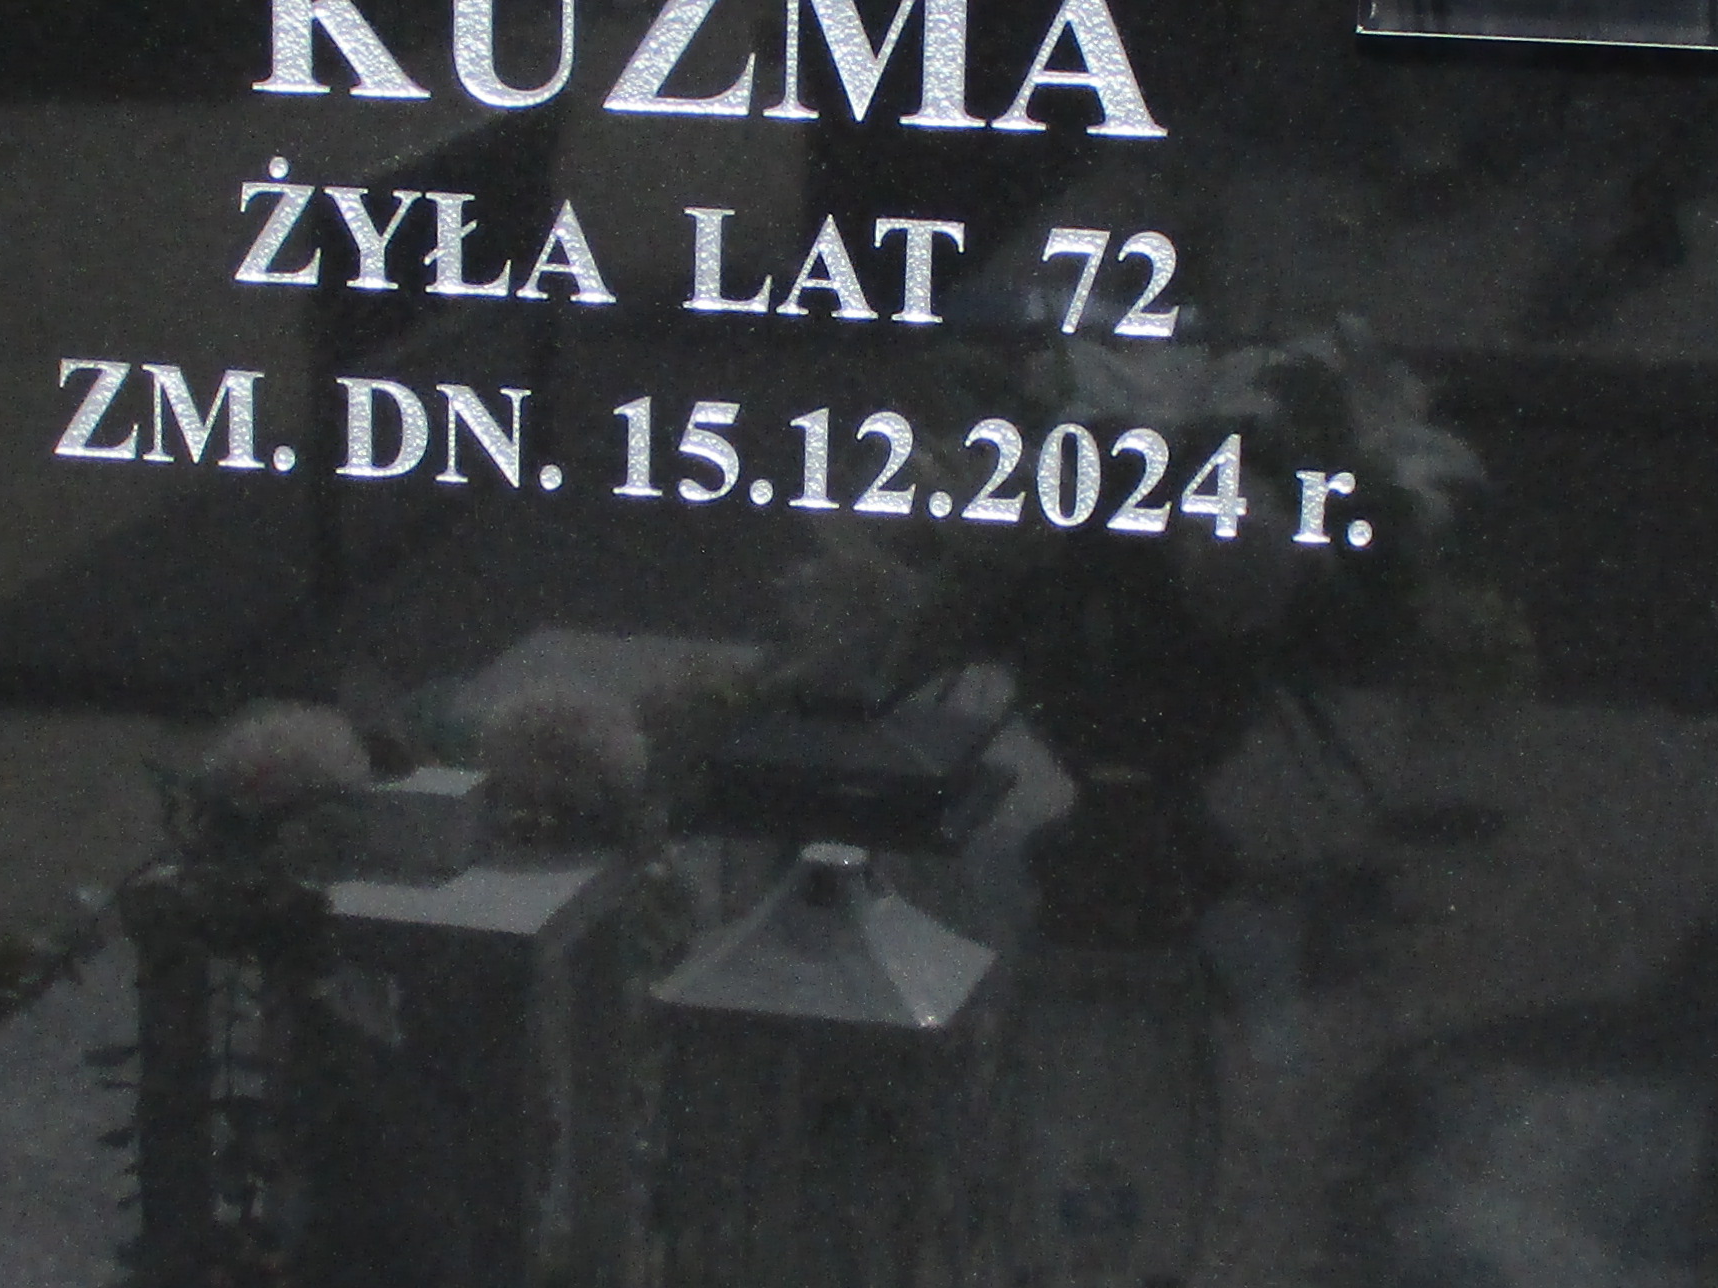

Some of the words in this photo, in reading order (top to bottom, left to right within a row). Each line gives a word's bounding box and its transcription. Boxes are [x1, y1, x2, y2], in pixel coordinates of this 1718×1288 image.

[233, 155, 618, 306] ŻYŁA
[681, 205, 966, 326] LAT
[1040, 226, 1181, 339] 72
[53, 356, 297, 473] ZM.
[334, 376, 564, 492] DN.
[611, 395, 1249, 540] 15.12.2024
[1291, 469, 1374, 549] r.
